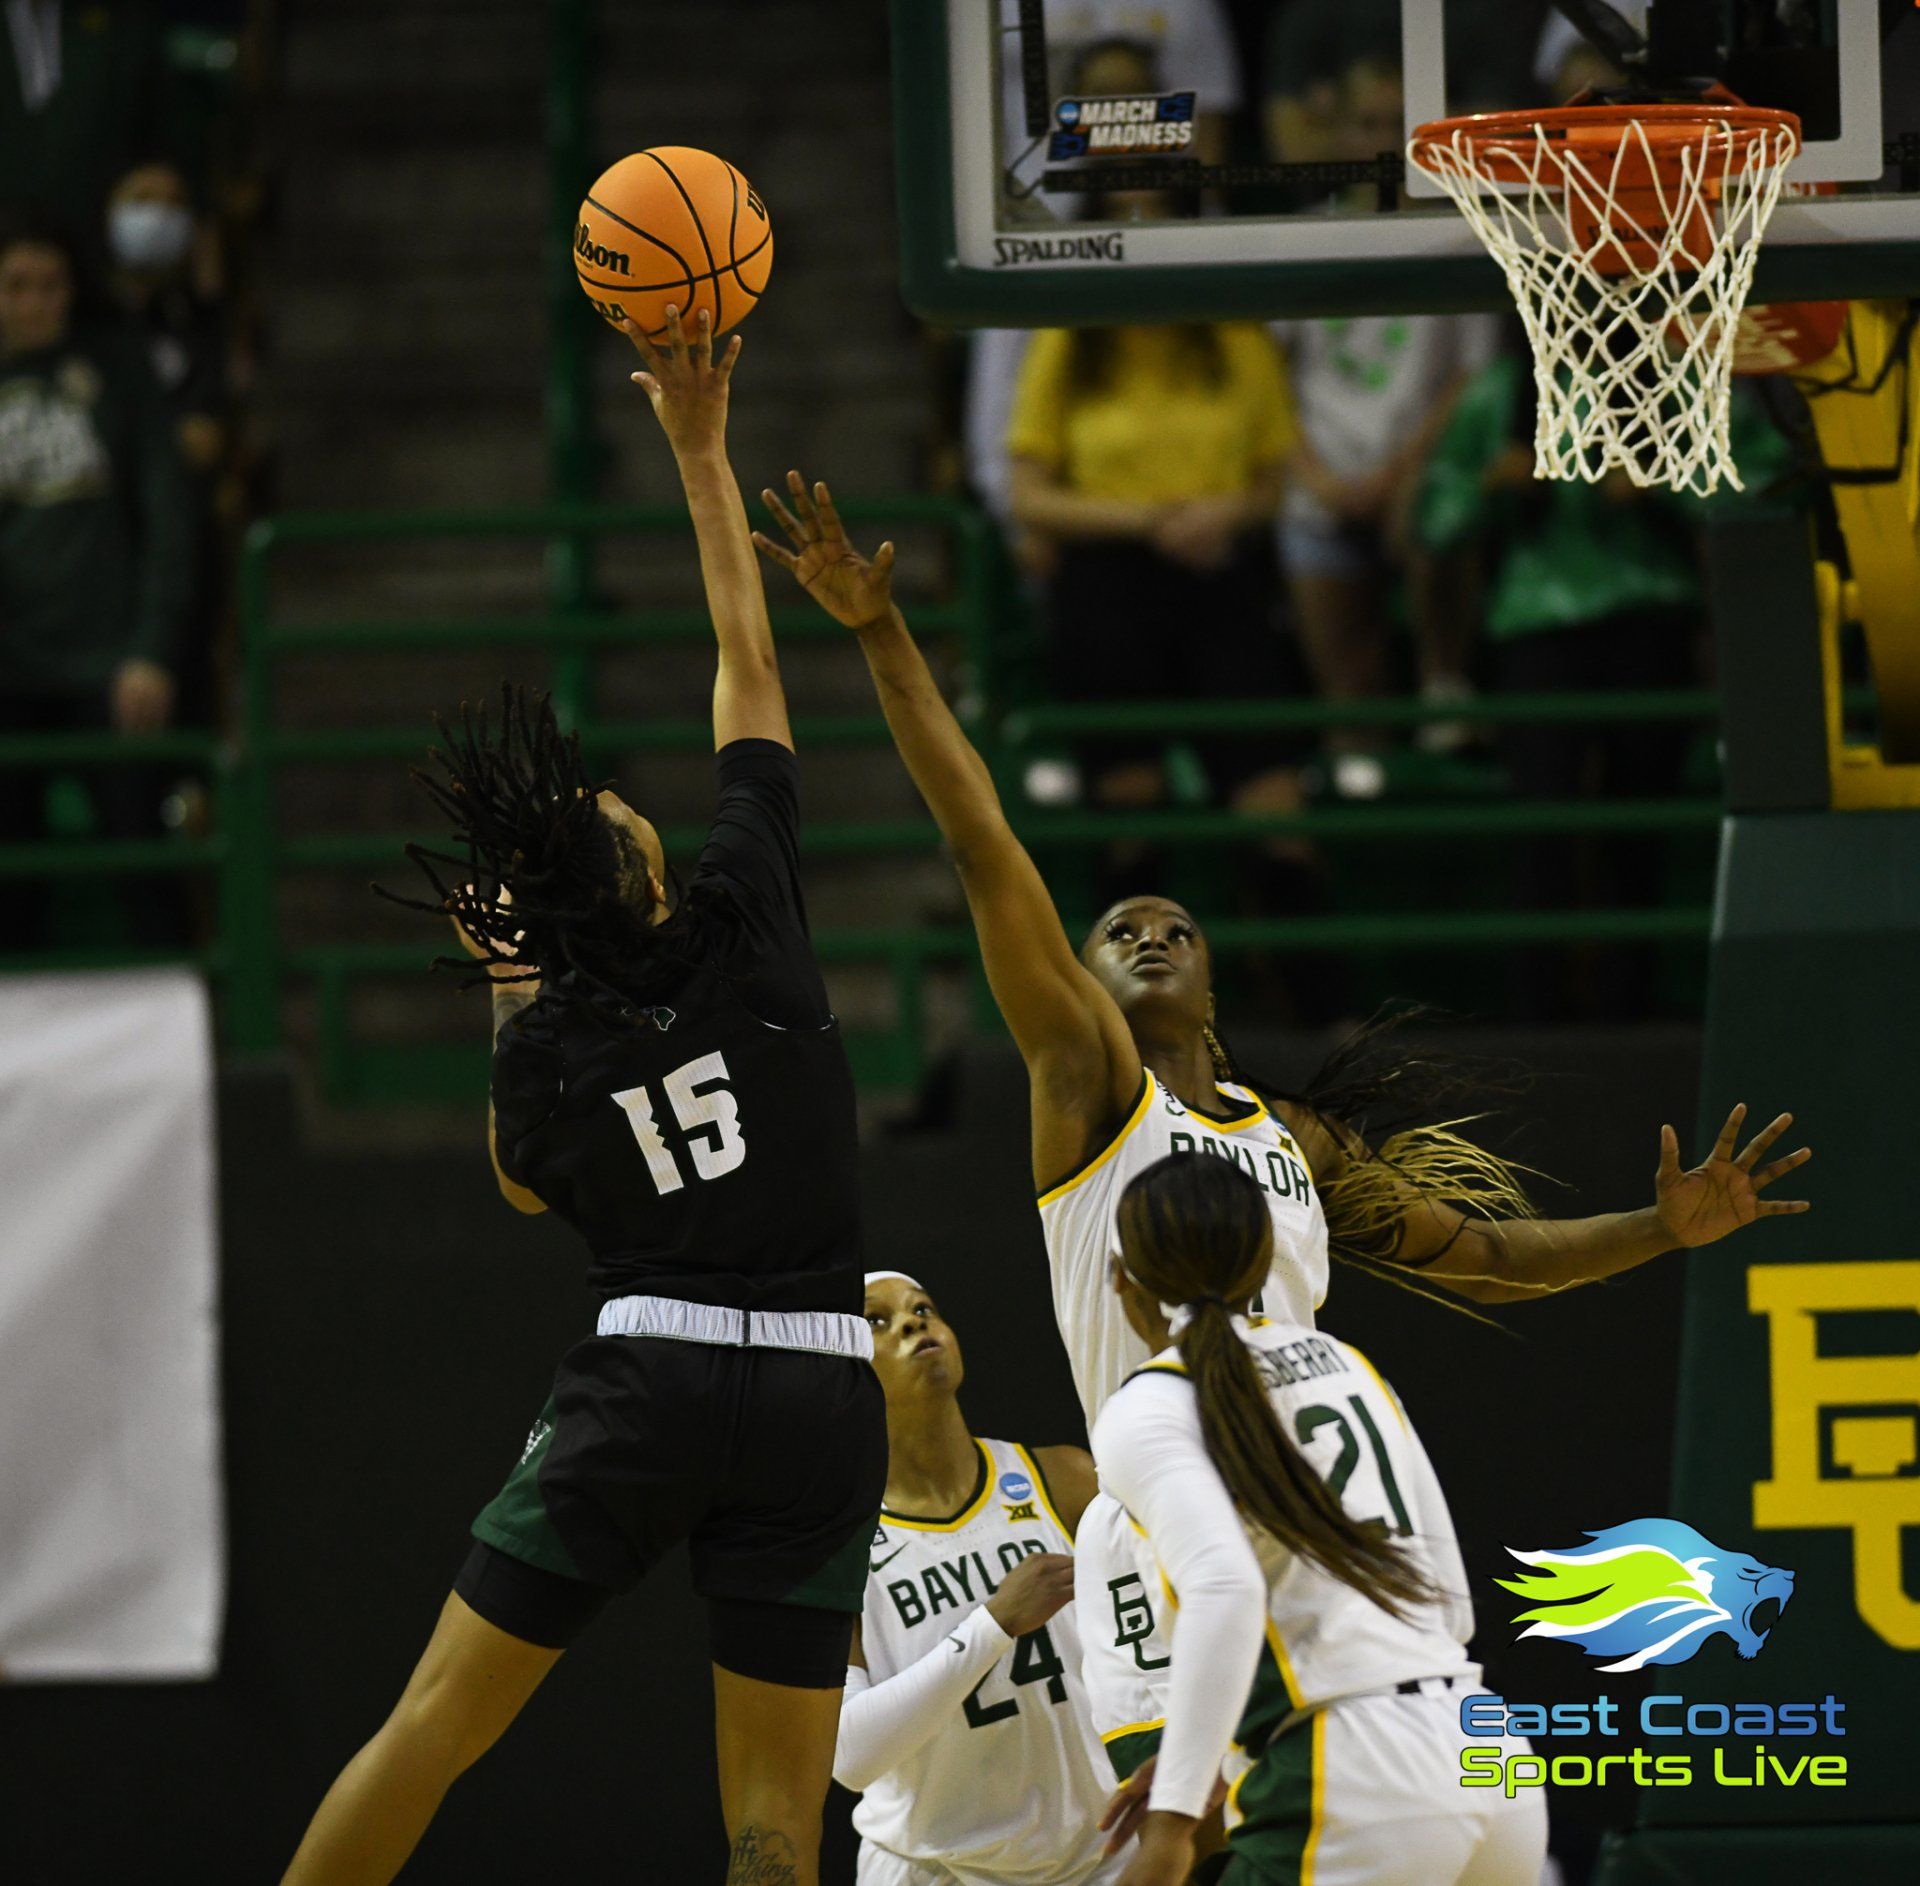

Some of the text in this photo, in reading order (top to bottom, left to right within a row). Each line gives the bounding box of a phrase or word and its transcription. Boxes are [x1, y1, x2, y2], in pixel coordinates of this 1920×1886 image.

[1080, 101, 1157, 124] MARCH
[1089, 121, 1193, 147] MADNESS
[994, 232, 1123, 267] SPALDING
[610, 1050, 747, 1195] 15
[1295, 1395, 1414, 1538] 21
